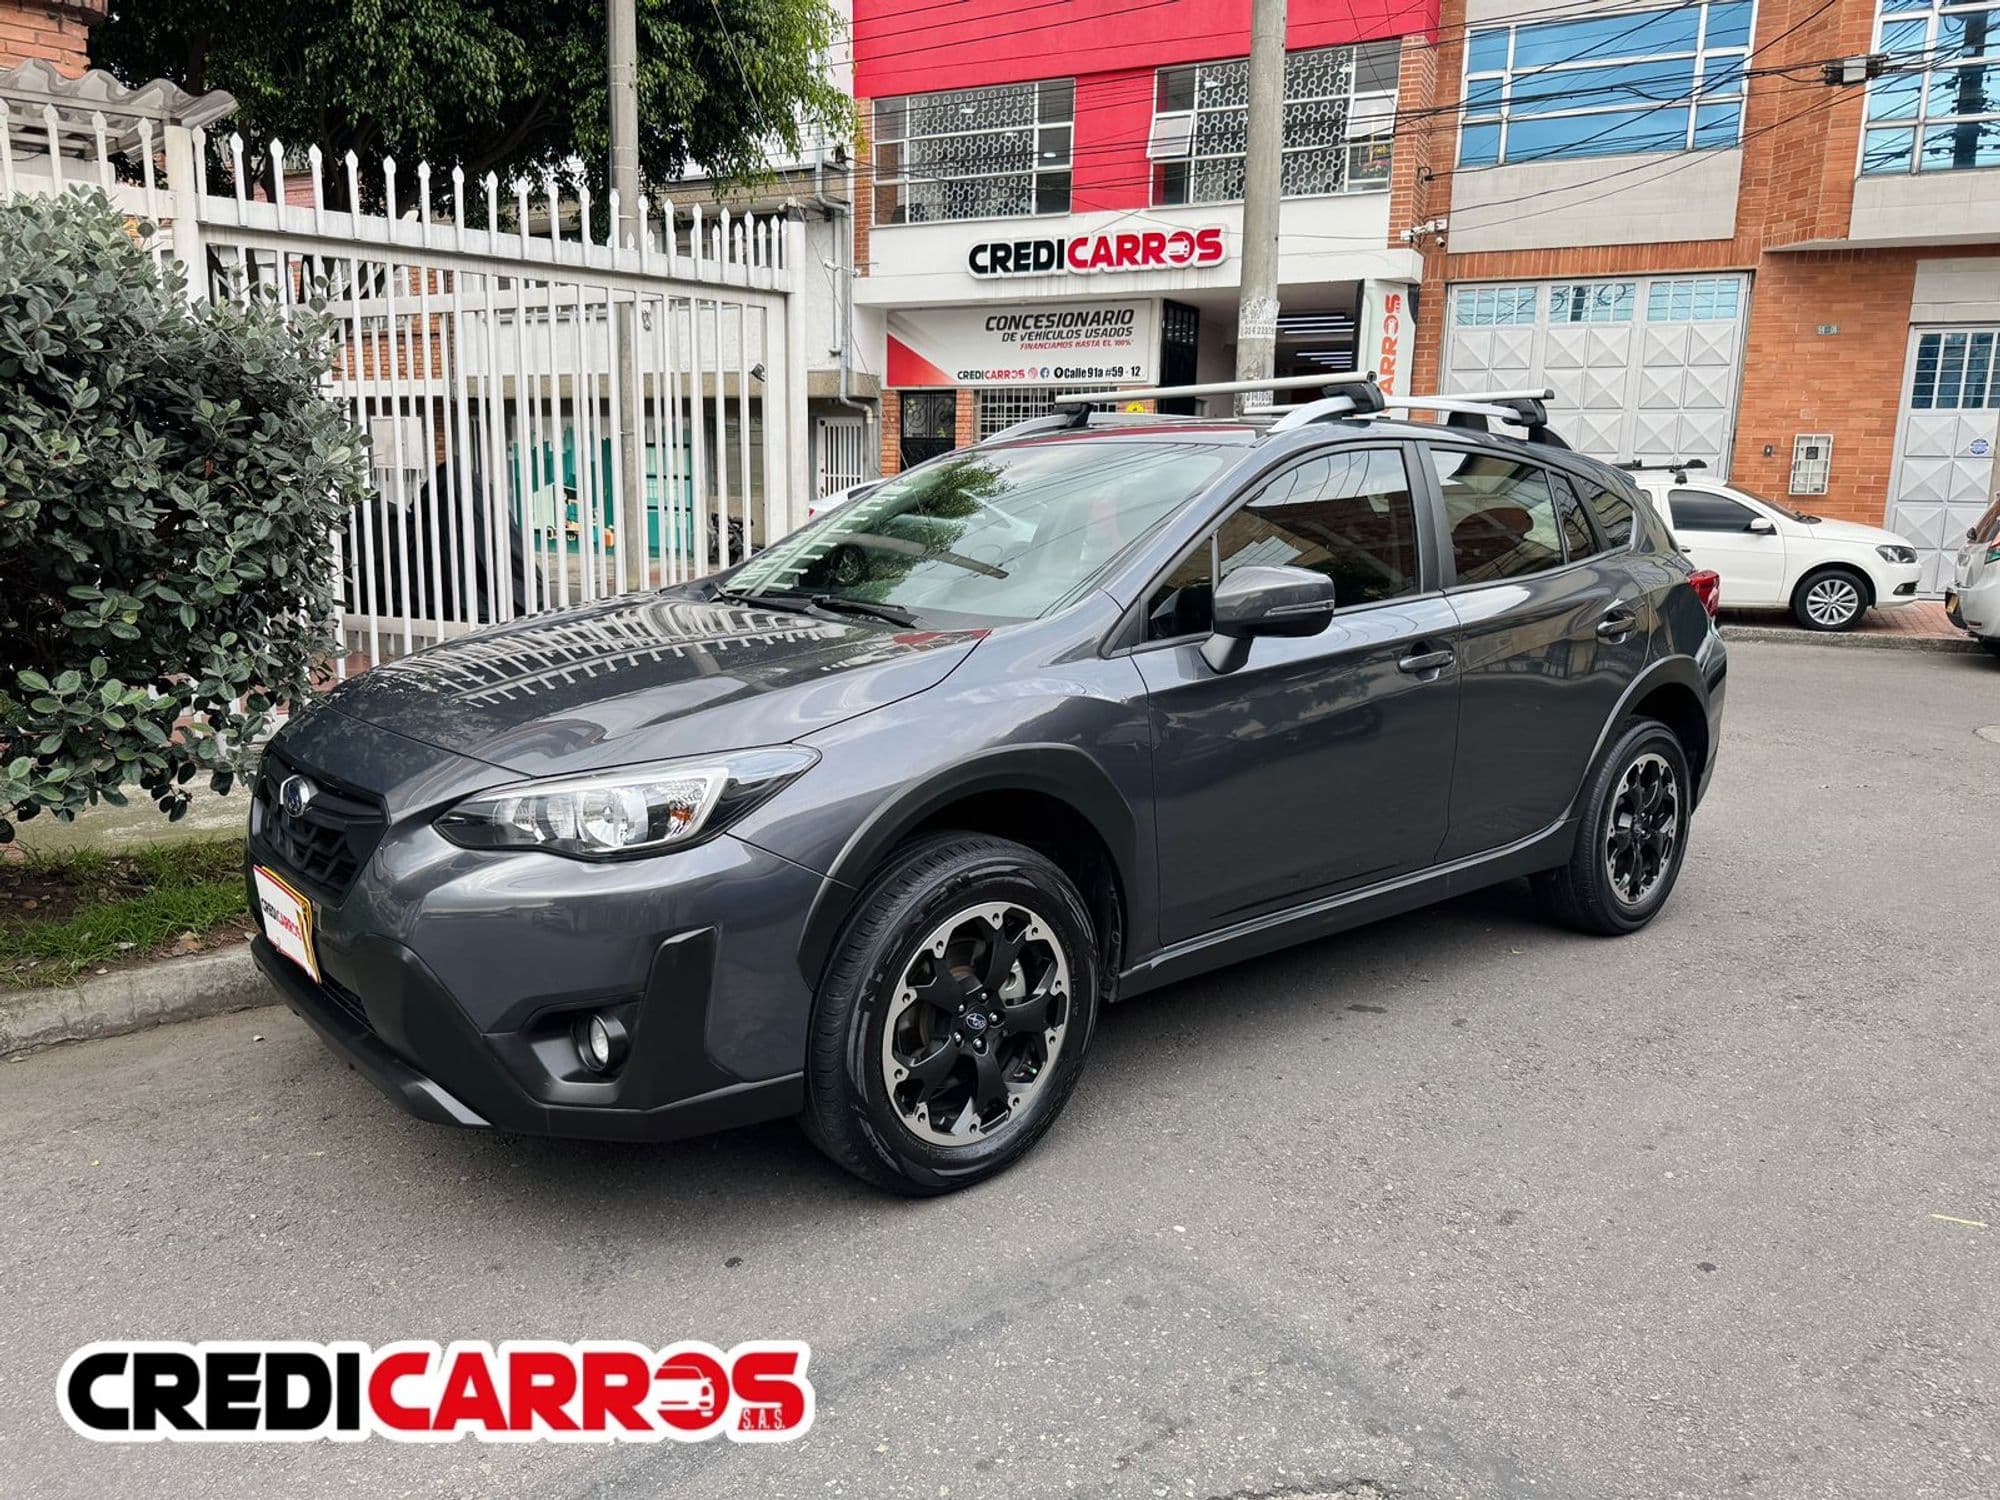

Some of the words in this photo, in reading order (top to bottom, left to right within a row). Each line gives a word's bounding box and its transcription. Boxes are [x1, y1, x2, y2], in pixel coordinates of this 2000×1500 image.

[968, 228, 1222, 274] CREDICARROS
[985, 309, 1135, 331] CONCESIONARIO
[1002, 332, 1016, 342] DE
[1085, 326, 1133, 339] USADOS
[1020, 340, 1073, 350] FINANCIAMOS
[1075, 339, 1100, 348] HASTA
[1379, 293, 1401, 414] ARROS
[957, 369, 1025, 380] CREDICARROS
[1064, 367, 1086, 378] Calle
[1105, 366, 1123, 378] #59
[1131, 366, 1141, 377] 12
